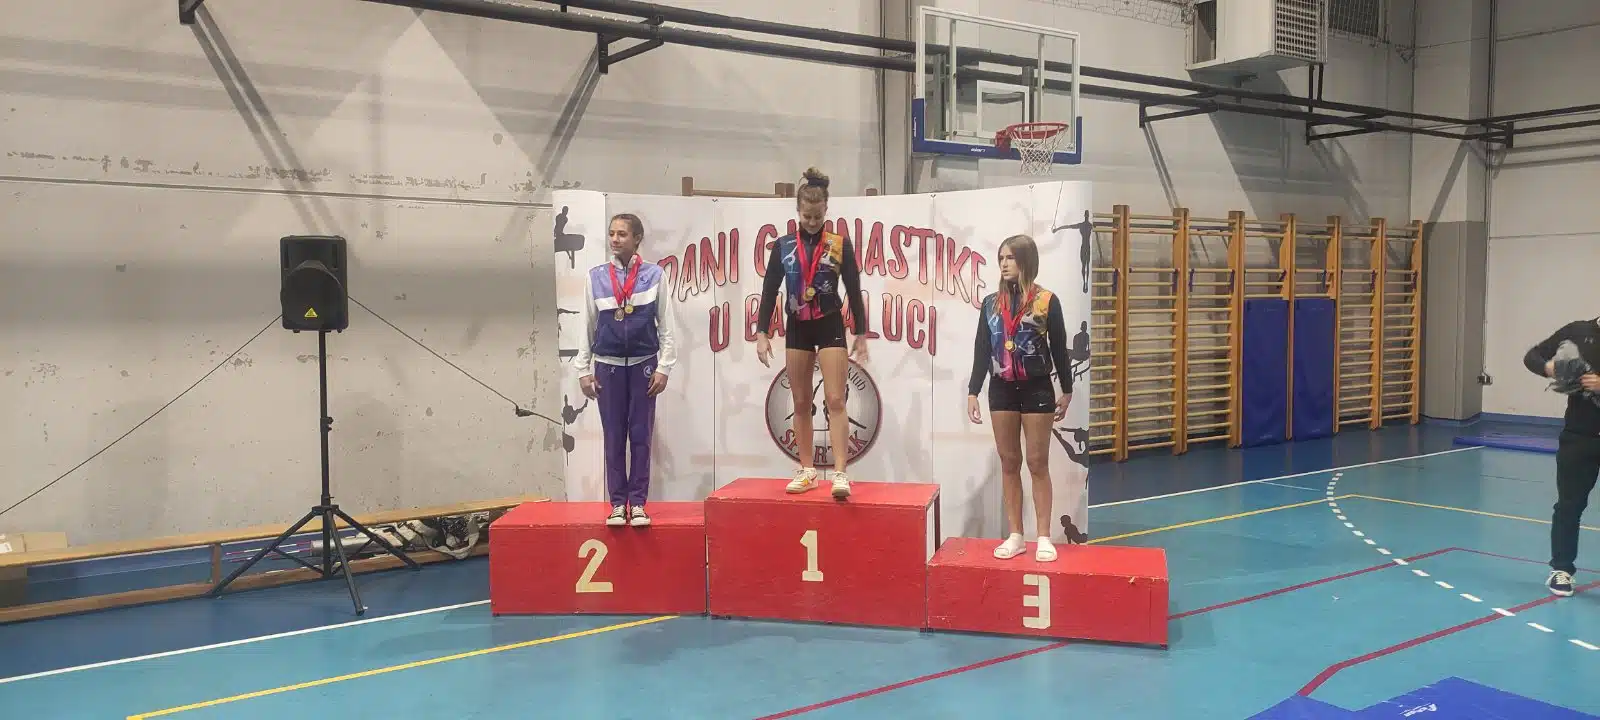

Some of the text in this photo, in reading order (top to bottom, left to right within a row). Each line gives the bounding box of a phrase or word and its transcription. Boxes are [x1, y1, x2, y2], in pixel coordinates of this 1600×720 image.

[709, 290, 936, 356] U BAALUCI
[576, 539, 613, 592] 2
[800, 530, 823, 581] 1
[1023, 574, 1050, 629] 3
